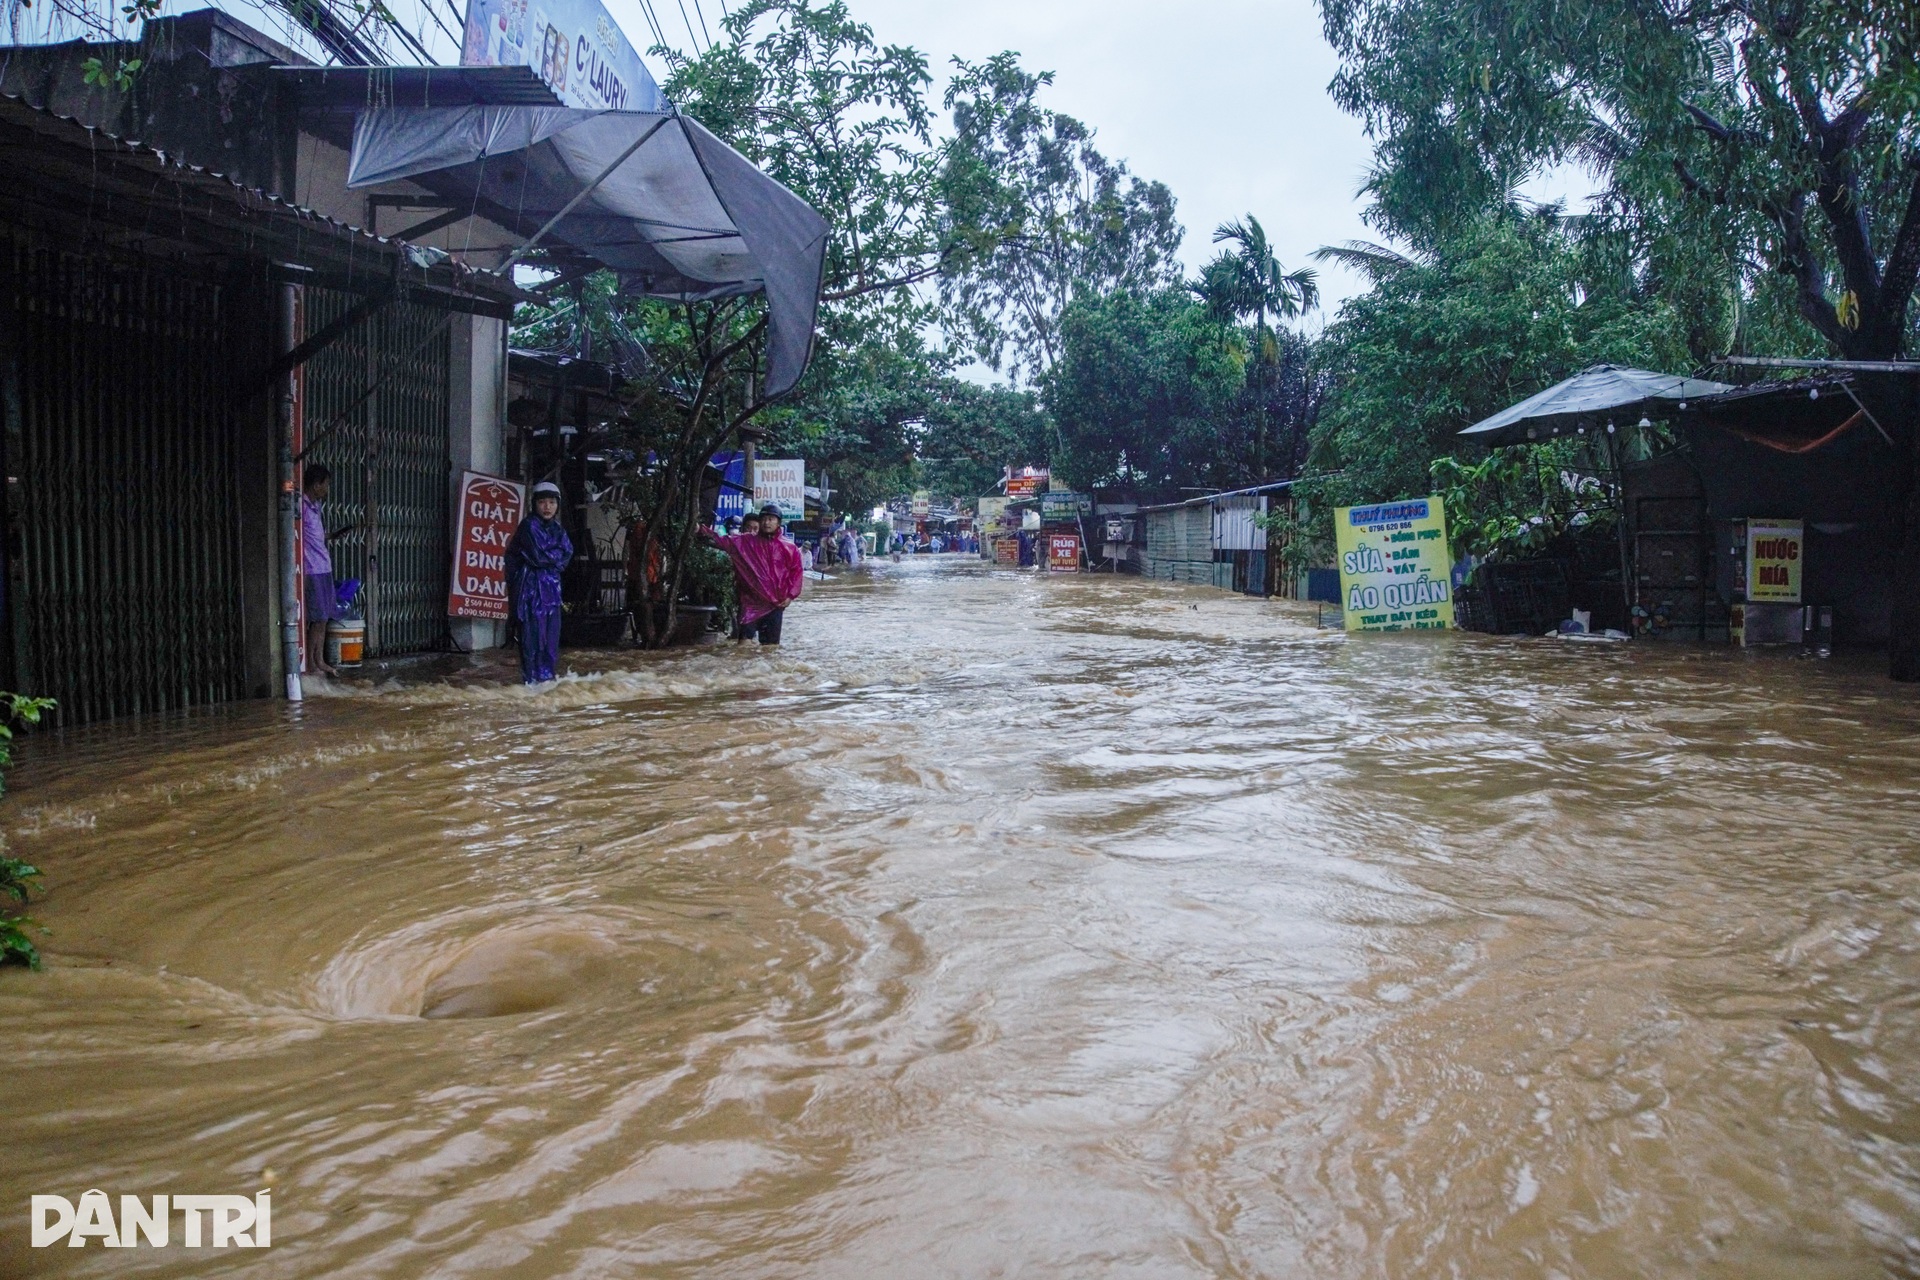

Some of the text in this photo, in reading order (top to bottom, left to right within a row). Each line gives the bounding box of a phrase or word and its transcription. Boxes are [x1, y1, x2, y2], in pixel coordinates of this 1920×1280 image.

[761, 469, 796, 484] NHỰA
[755, 484, 803, 499] ĐÀI LOAN
[471, 500, 516, 524] GIẶT
[471, 524, 511, 548] SẤY
[1369, 524, 1384, 532] 0796
[1057, 549, 1072, 558] XE
[1344, 542, 1384, 575] SỬA
[1756, 538, 1798, 560] NƯỚC
[1393, 562, 1416, 574] VÁY
[1760, 564, 1789, 586] MÍA
[466, 576, 507, 597] DÂN
[1348, 574, 1449, 611] ÁO QUẦN
[1361, 614, 1387, 624] THAY
[1416, 608, 1438, 620] KÉO
